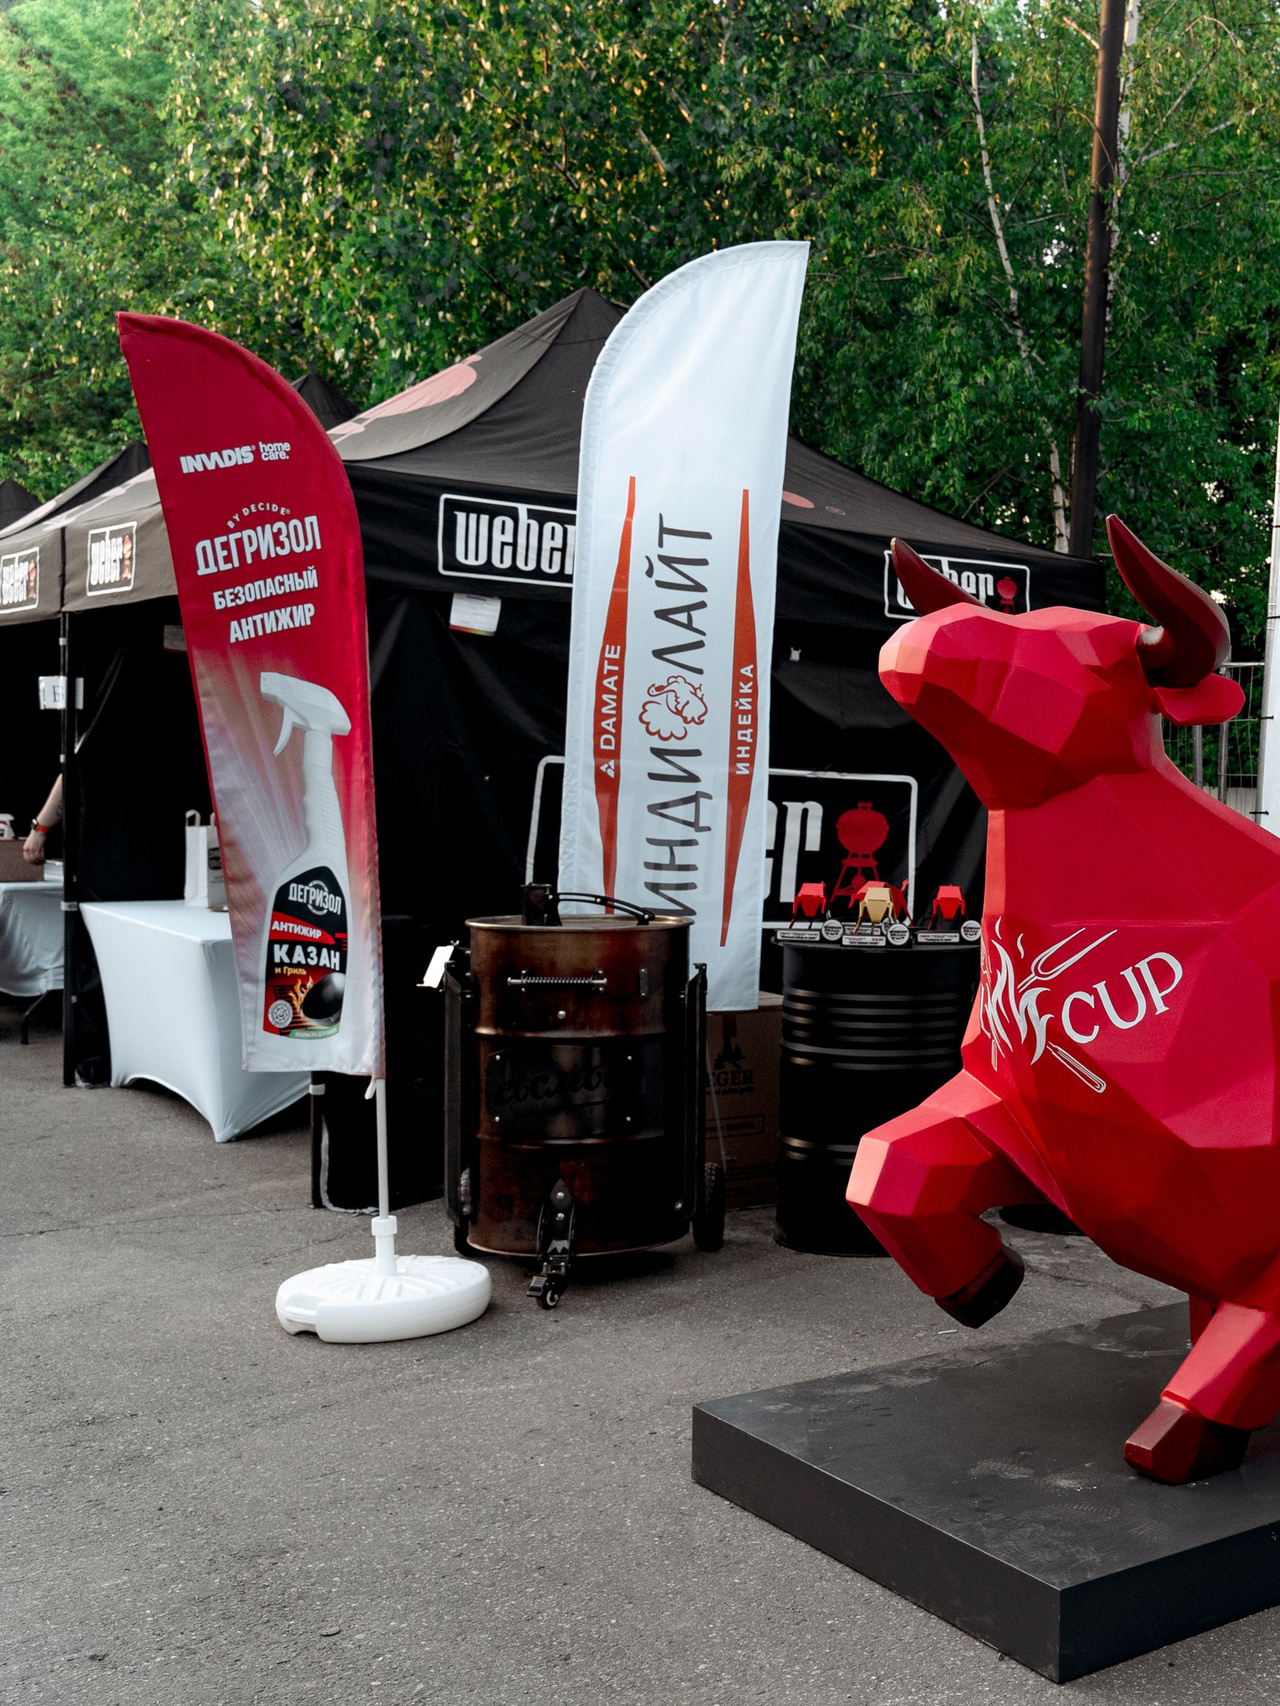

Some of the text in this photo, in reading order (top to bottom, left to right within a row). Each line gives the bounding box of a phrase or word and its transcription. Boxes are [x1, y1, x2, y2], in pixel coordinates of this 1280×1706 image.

[259, 441, 291, 453] home
[261, 449, 290, 462] care.
[226, 513, 240, 529] BY
[195, 514, 322, 576] ДЕГРИЗОЛ
[212, 565, 319, 611] БЕЗОПАСНЫЙ
[229, 603, 316, 643] АНТИЖИР
[600, 643, 622, 751] DAMATE
[735, 664, 754, 776] ИНДЕЙКА
[288, 882, 342, 916] ДЕГРИЗОЛ
[271, 919, 323, 940] АНТИЖИР
[273, 943, 341, 972] КАЗАН
[282, 966, 308, 977] Гриль
[1060, 951, 1184, 1045] CUP
